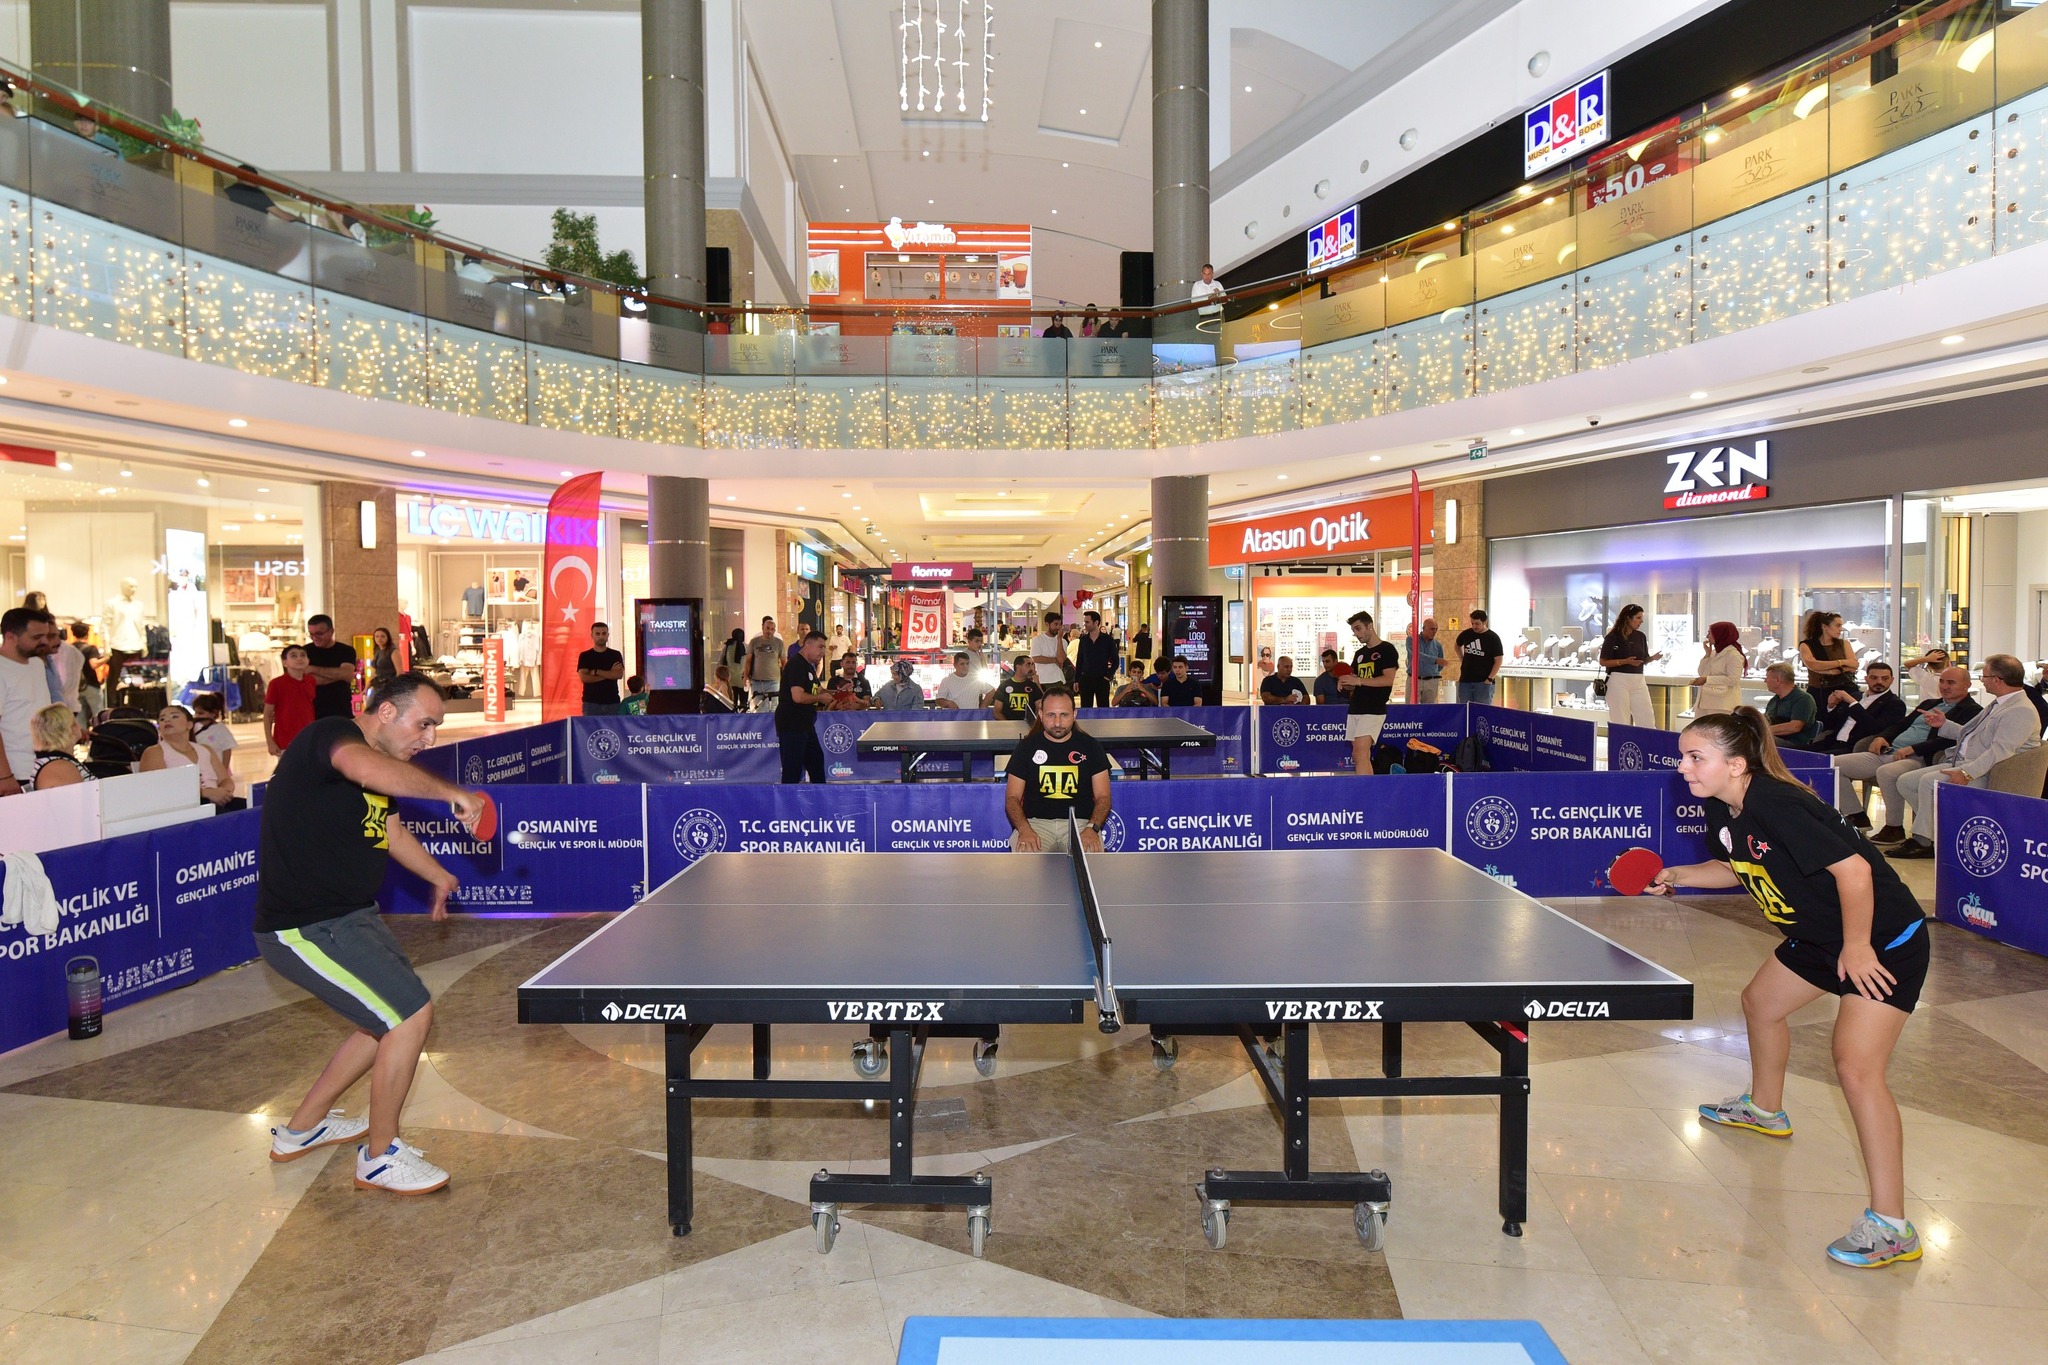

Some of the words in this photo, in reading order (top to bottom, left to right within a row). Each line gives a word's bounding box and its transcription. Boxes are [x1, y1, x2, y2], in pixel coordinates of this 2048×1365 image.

[1889, 82, 1923, 107] PARK
[1528, 94, 1601, 151] D&R
[1527, 145, 1551, 163] MUSIC
[1578, 118, 1604, 138] BOOK
[1744, 147, 1773, 170] PARK
[1620, 200, 1645, 219] PARK
[1308, 222, 1354, 262] D&R
[1513, 242, 1535, 258] PARK
[739, 343, 759, 352] PARK
[1100, 346, 1119, 355] PARK
[1664, 440, 1768, 493] ZEN
[1676, 483, 1754, 507] diamond
[408, 501, 461, 537] LC
[1241, 527, 1306, 554] Atasun
[1310, 511, 1370, 551] Optik
[911, 566, 953, 577] flormar
[911, 595, 940, 606] flormar
[911, 612, 938, 633] 50
[1189, 632, 1205, 640] LOGO
[1464, 648, 1485, 657] adidas
[485, 649, 498, 715] İNDİRİM
[1009, 693, 1030, 711] ATA
[1383, 722, 1423, 730] OSMANİYE
[1492, 725, 1500, 734] T.C.
[1500, 726, 1518, 740] GENÇLİK
[1518, 730, 1526, 739] VE
[628, 735, 643, 743] T.C.
[645, 732, 682, 744] GENÇLİK
[716, 731, 762, 741] OSMANİYE
[1492, 737, 1504, 746] SPOR
[1504, 739, 1529, 752] BAKANLIĞI
[1536, 734, 1562, 748] OSMANİYE
[628, 747, 652, 755] SPOR
[654, 743, 702, 754] BAKANLIĞI
[487, 760, 496, 769] T.C.
[496, 752, 516, 767] GENÇLİK
[516, 751, 522, 760] VE
[1280, 760, 1299, 768] OKUL
[1648, 753, 1661, 764] T.C.
[487, 772, 500, 783] SPOR
[500, 764, 525, 779] BAKANLIĞI
[595, 775, 620, 783] OKUL
[1039, 765, 1079, 799] ATA
[1138, 815, 1165, 829] T.C.
[1167, 811, 1231, 832] GENÇLİK
[1234, 814, 1253, 827] VE
[1286, 810, 1364, 826] OSMANİYE
[1531, 806, 1556, 821] T.C.
[1559, 803, 1622, 824] GENÇLİK
[1625, 805, 1643, 818] VE
[517, 817, 598, 834] OSMANİYE
[739, 820, 766, 834] T.C.
[769, 817, 833, 836] GENÇLİK
[836, 820, 856, 833] VE
[891, 816, 972, 833] OSMANİYE
[1530, 827, 1570, 840] SPOR
[1573, 825, 1652, 839] BAKANLIĞI
[518, 839, 556, 850] GENÇLİK
[560, 840, 571, 848] VE
[573, 840, 597, 848] SPOR
[598, 838, 607, 848] İL
[891, 838, 930, 850] GENÇLİK
[934, 840, 945, 848] VE
[947, 839, 970, 849] SPOR
[972, 838, 980, 848] İL
[1138, 836, 1178, 850] SPOR
[1182, 832, 1262, 850] BAKANLIĞI
[1287, 831, 1324, 843] GENÇLİK
[1328, 831, 1339, 841] VE
[1340, 830, 1363, 840] SPOR
[1364, 829, 1372, 839] İL
[1374, 827, 1429, 839] MÜDÜRLÜĞÜ
[740, 841, 780, 853] SPOR
[784, 838, 866, 853] BAKANLIĞI
[175, 850, 256, 885] OSMANİYE
[114, 880, 139, 902] VE
[176, 884, 218, 905] GENÇLİK
[220, 881, 232, 892] VE
[233, 874, 256, 889] SPOR
[1962, 904, 1998, 926] OKUL
[45, 905, 150, 950] BAKANLIĞI
[624, 1004, 688, 1020] DELTA
[826, 1002, 945, 1021] VERTEX
[1265, 1001, 1384, 1020] VERTEX
[1545, 1001, 1610, 1018] DELTA
